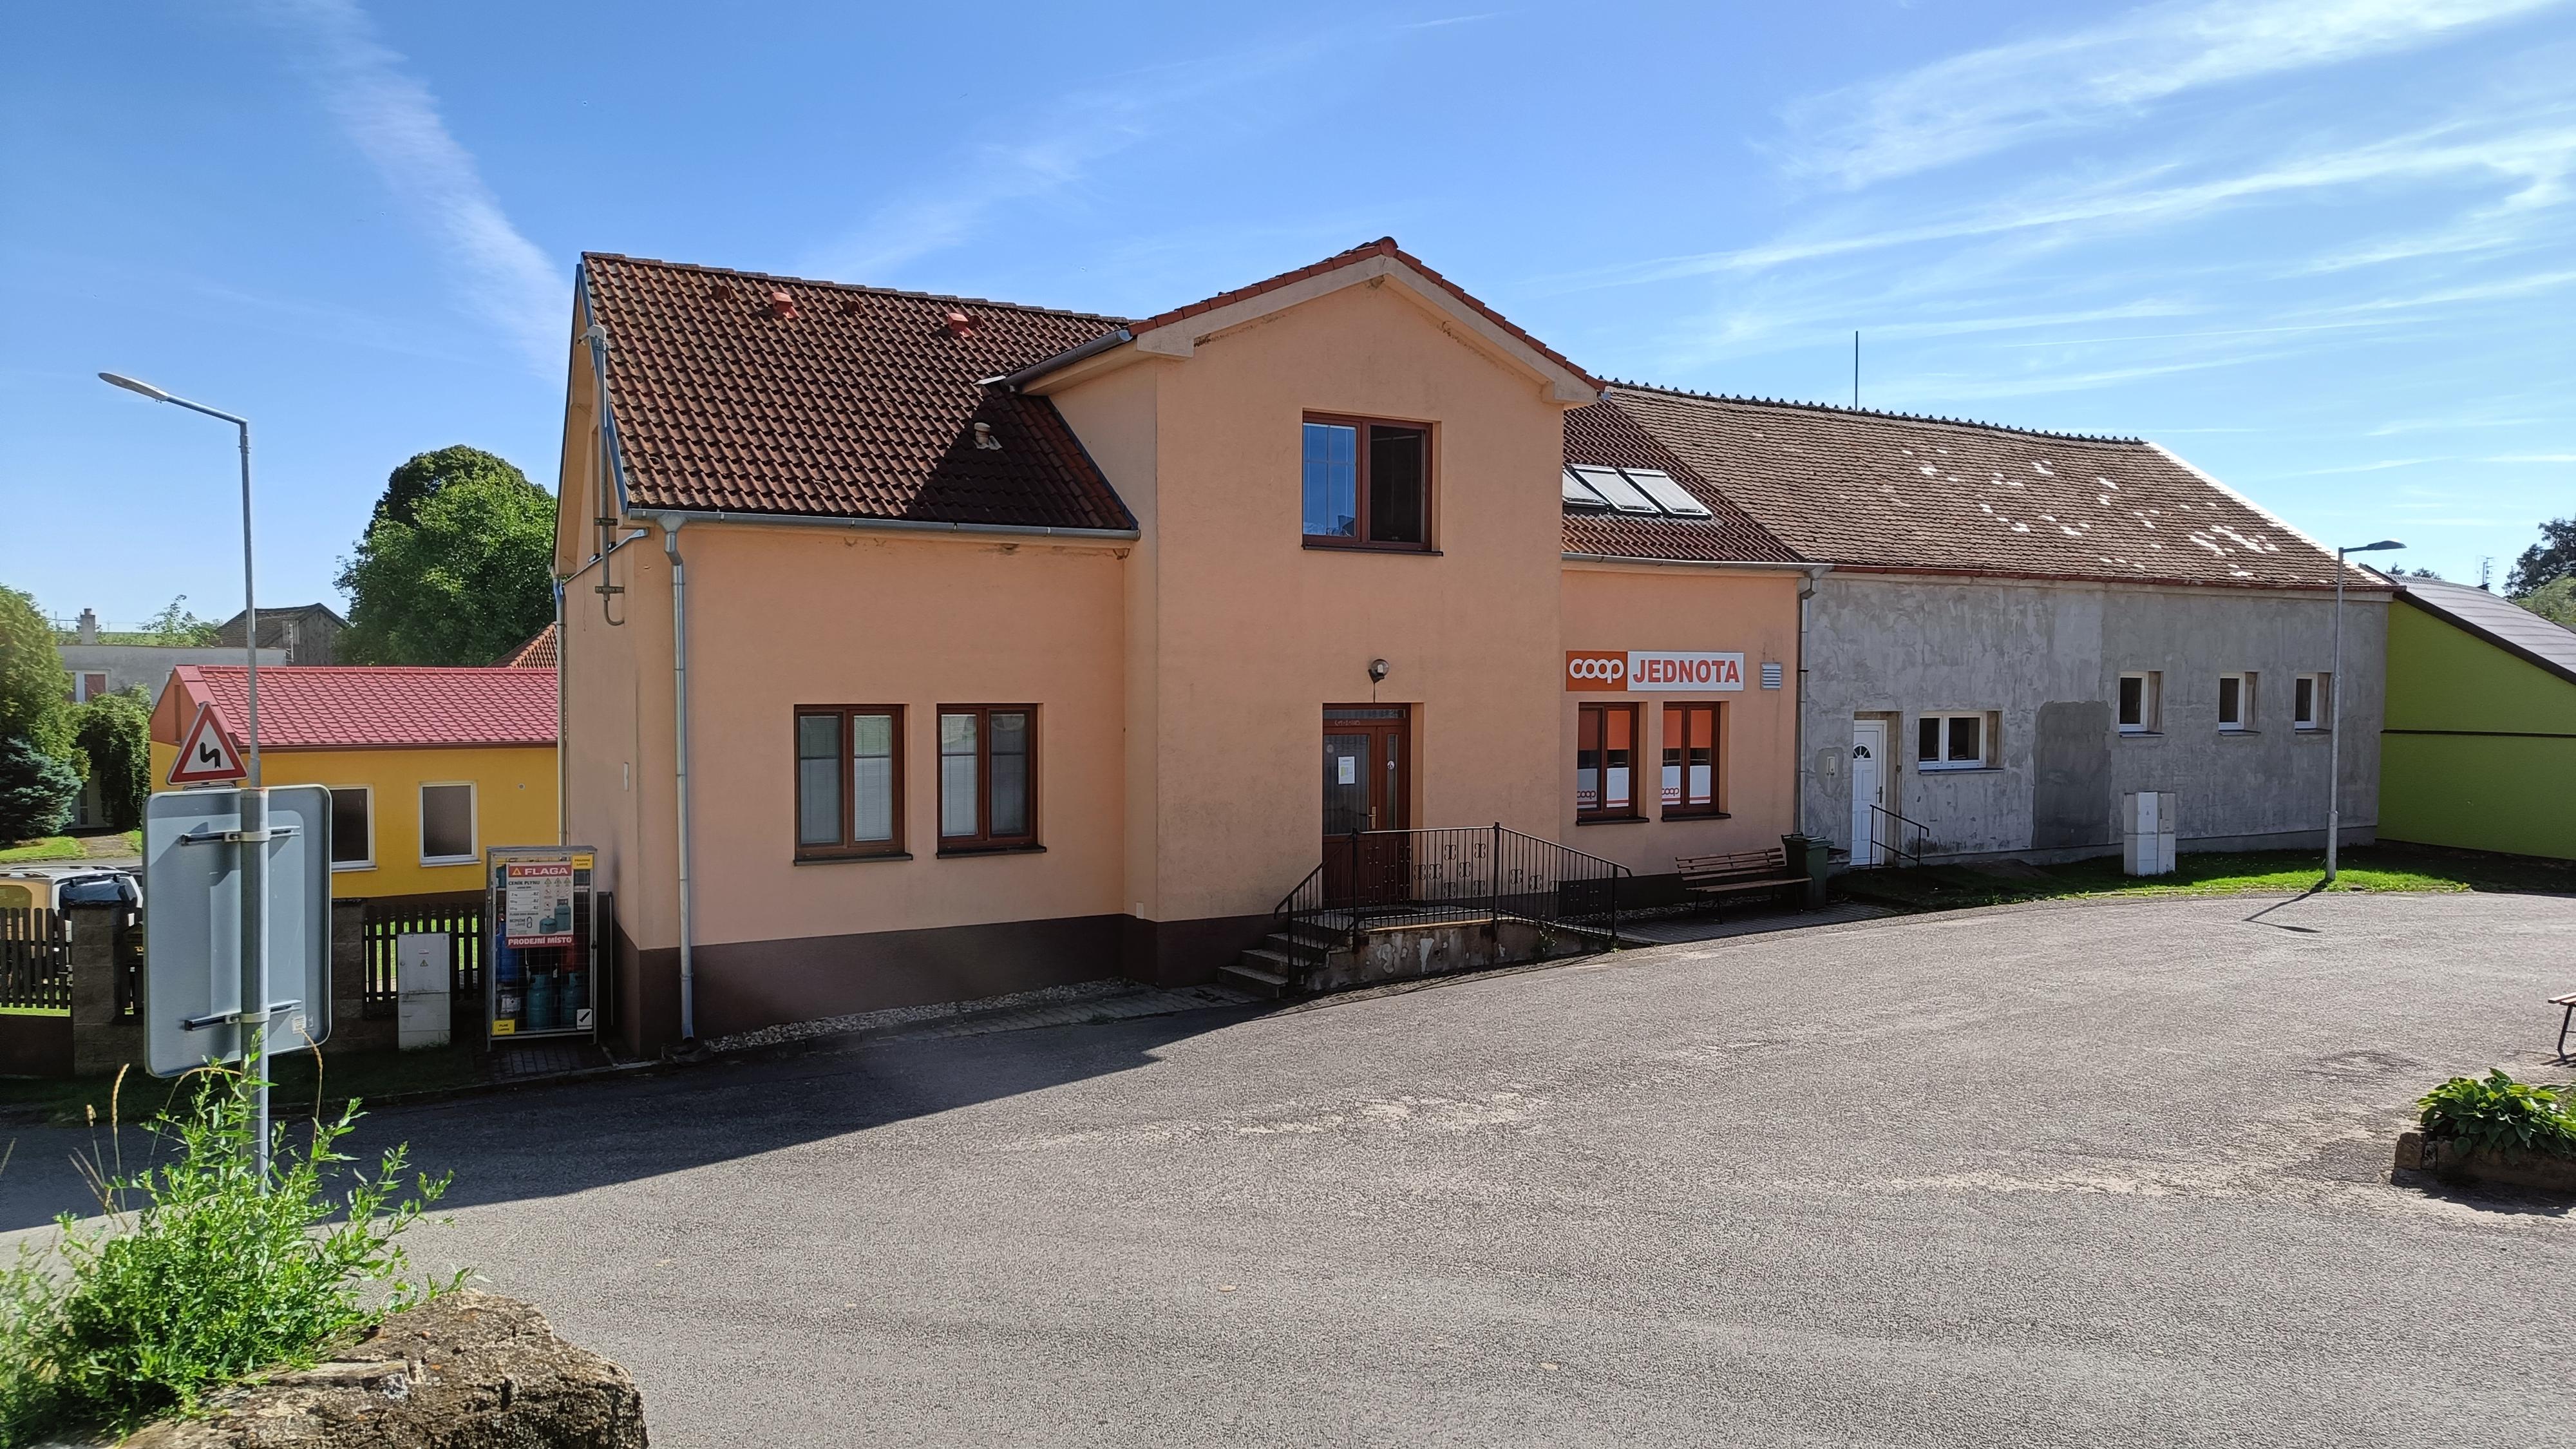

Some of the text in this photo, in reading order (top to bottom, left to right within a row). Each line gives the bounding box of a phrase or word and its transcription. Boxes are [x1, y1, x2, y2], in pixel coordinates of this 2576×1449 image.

[1569, 658, 1741, 684] coop JEDNOTA
[524, 867, 568, 875] FLAGA
[508, 936, 573, 945] PRODEJNÍ MÍSTO
